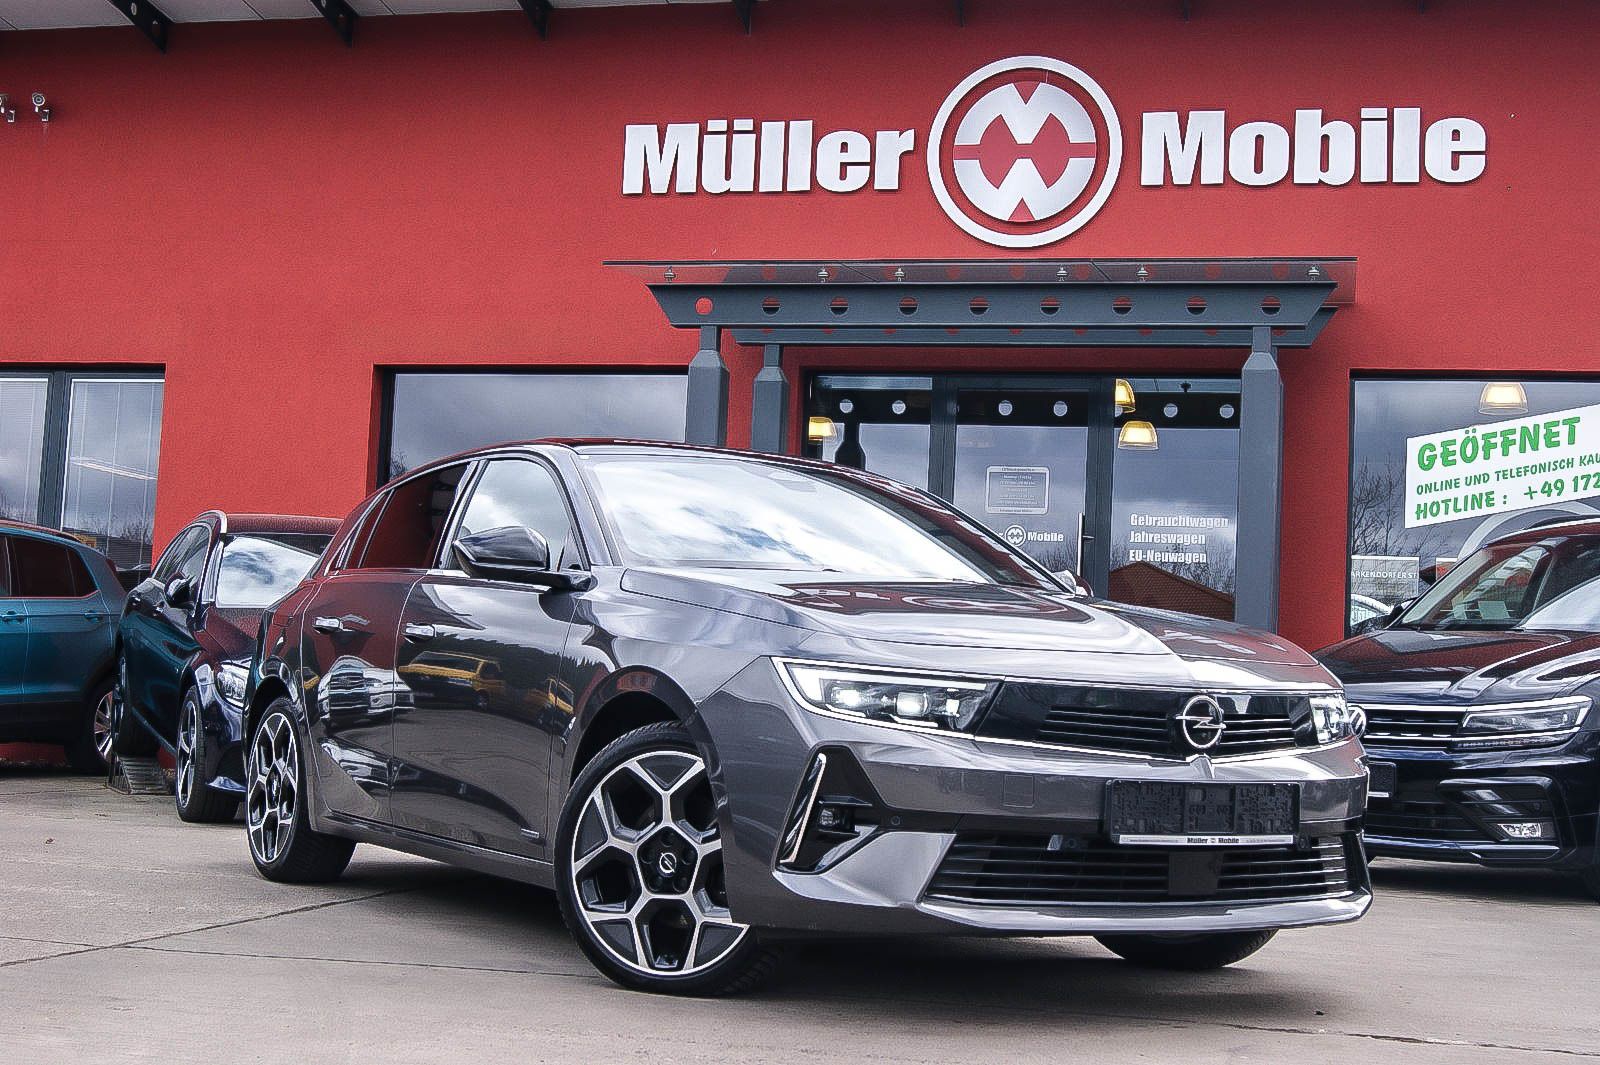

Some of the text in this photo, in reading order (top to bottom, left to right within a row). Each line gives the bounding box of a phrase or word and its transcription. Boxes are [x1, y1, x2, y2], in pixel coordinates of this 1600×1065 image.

[622, 107, 1486, 195] Müller Mobile
[1417, 416, 1581, 471] GEÖFFNET
[1416, 478, 1460, 495] ONLINE
[1465, 473, 1490, 487] UND
[1495, 457, 1574, 482] TELEFONISCH
[1130, 513, 1229, 529] Gebrauchtwagen
[1027, 531, 1064, 542] Mobile
[1129, 531, 1206, 546] Jahreswagen
[1129, 549, 1206, 564] EU-Neuwagen
